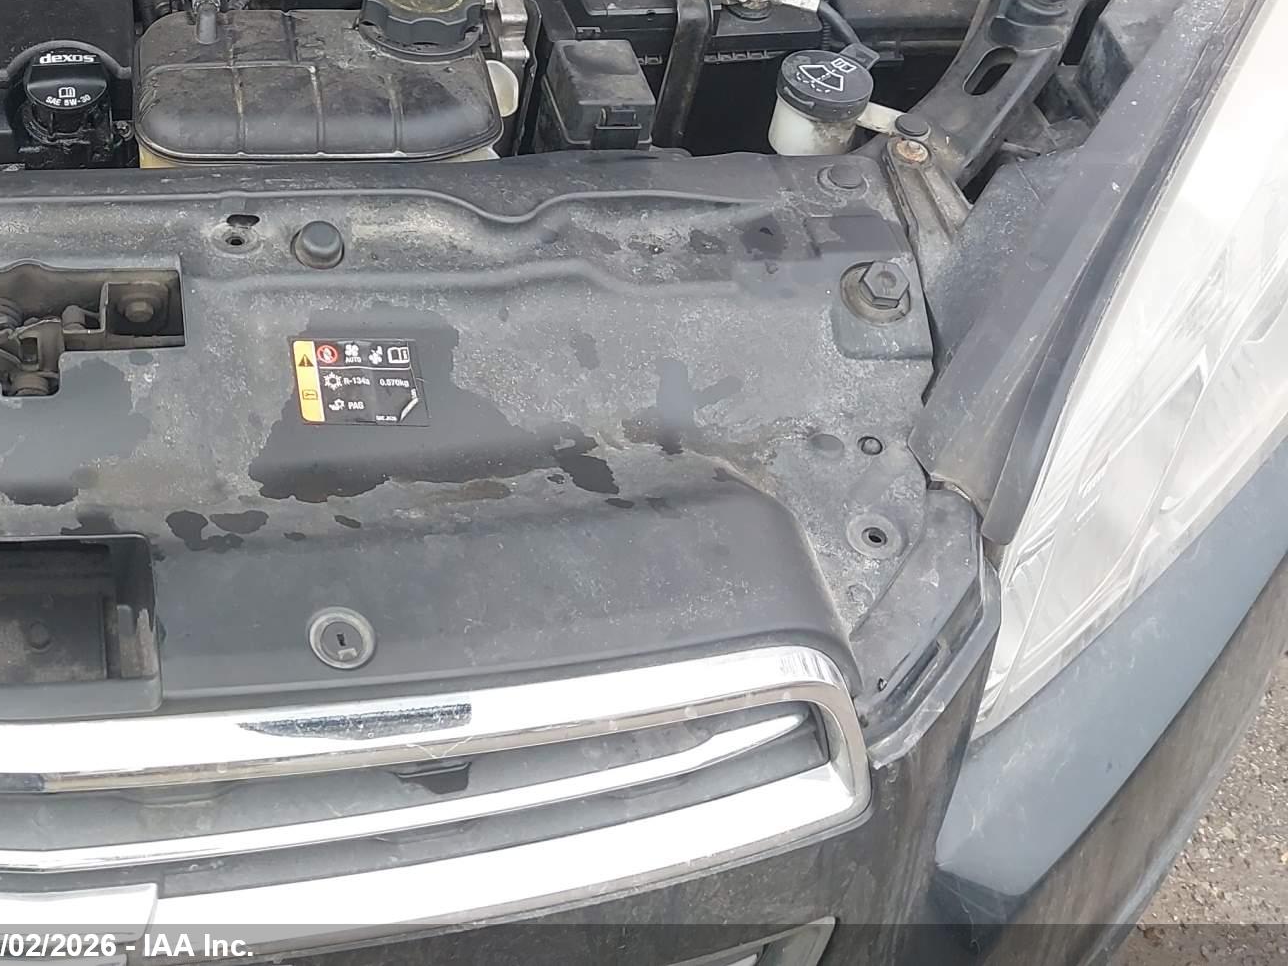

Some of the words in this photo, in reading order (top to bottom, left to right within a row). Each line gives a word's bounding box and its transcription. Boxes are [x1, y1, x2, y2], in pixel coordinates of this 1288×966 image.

[39, 52, 97, 64] dexos
[45, 96, 62, 106] SAE
[64, 94, 92, 106] 5W-30
[343, 377, 371, 386] R-134a
[348, 401, 365, 410] PAG
